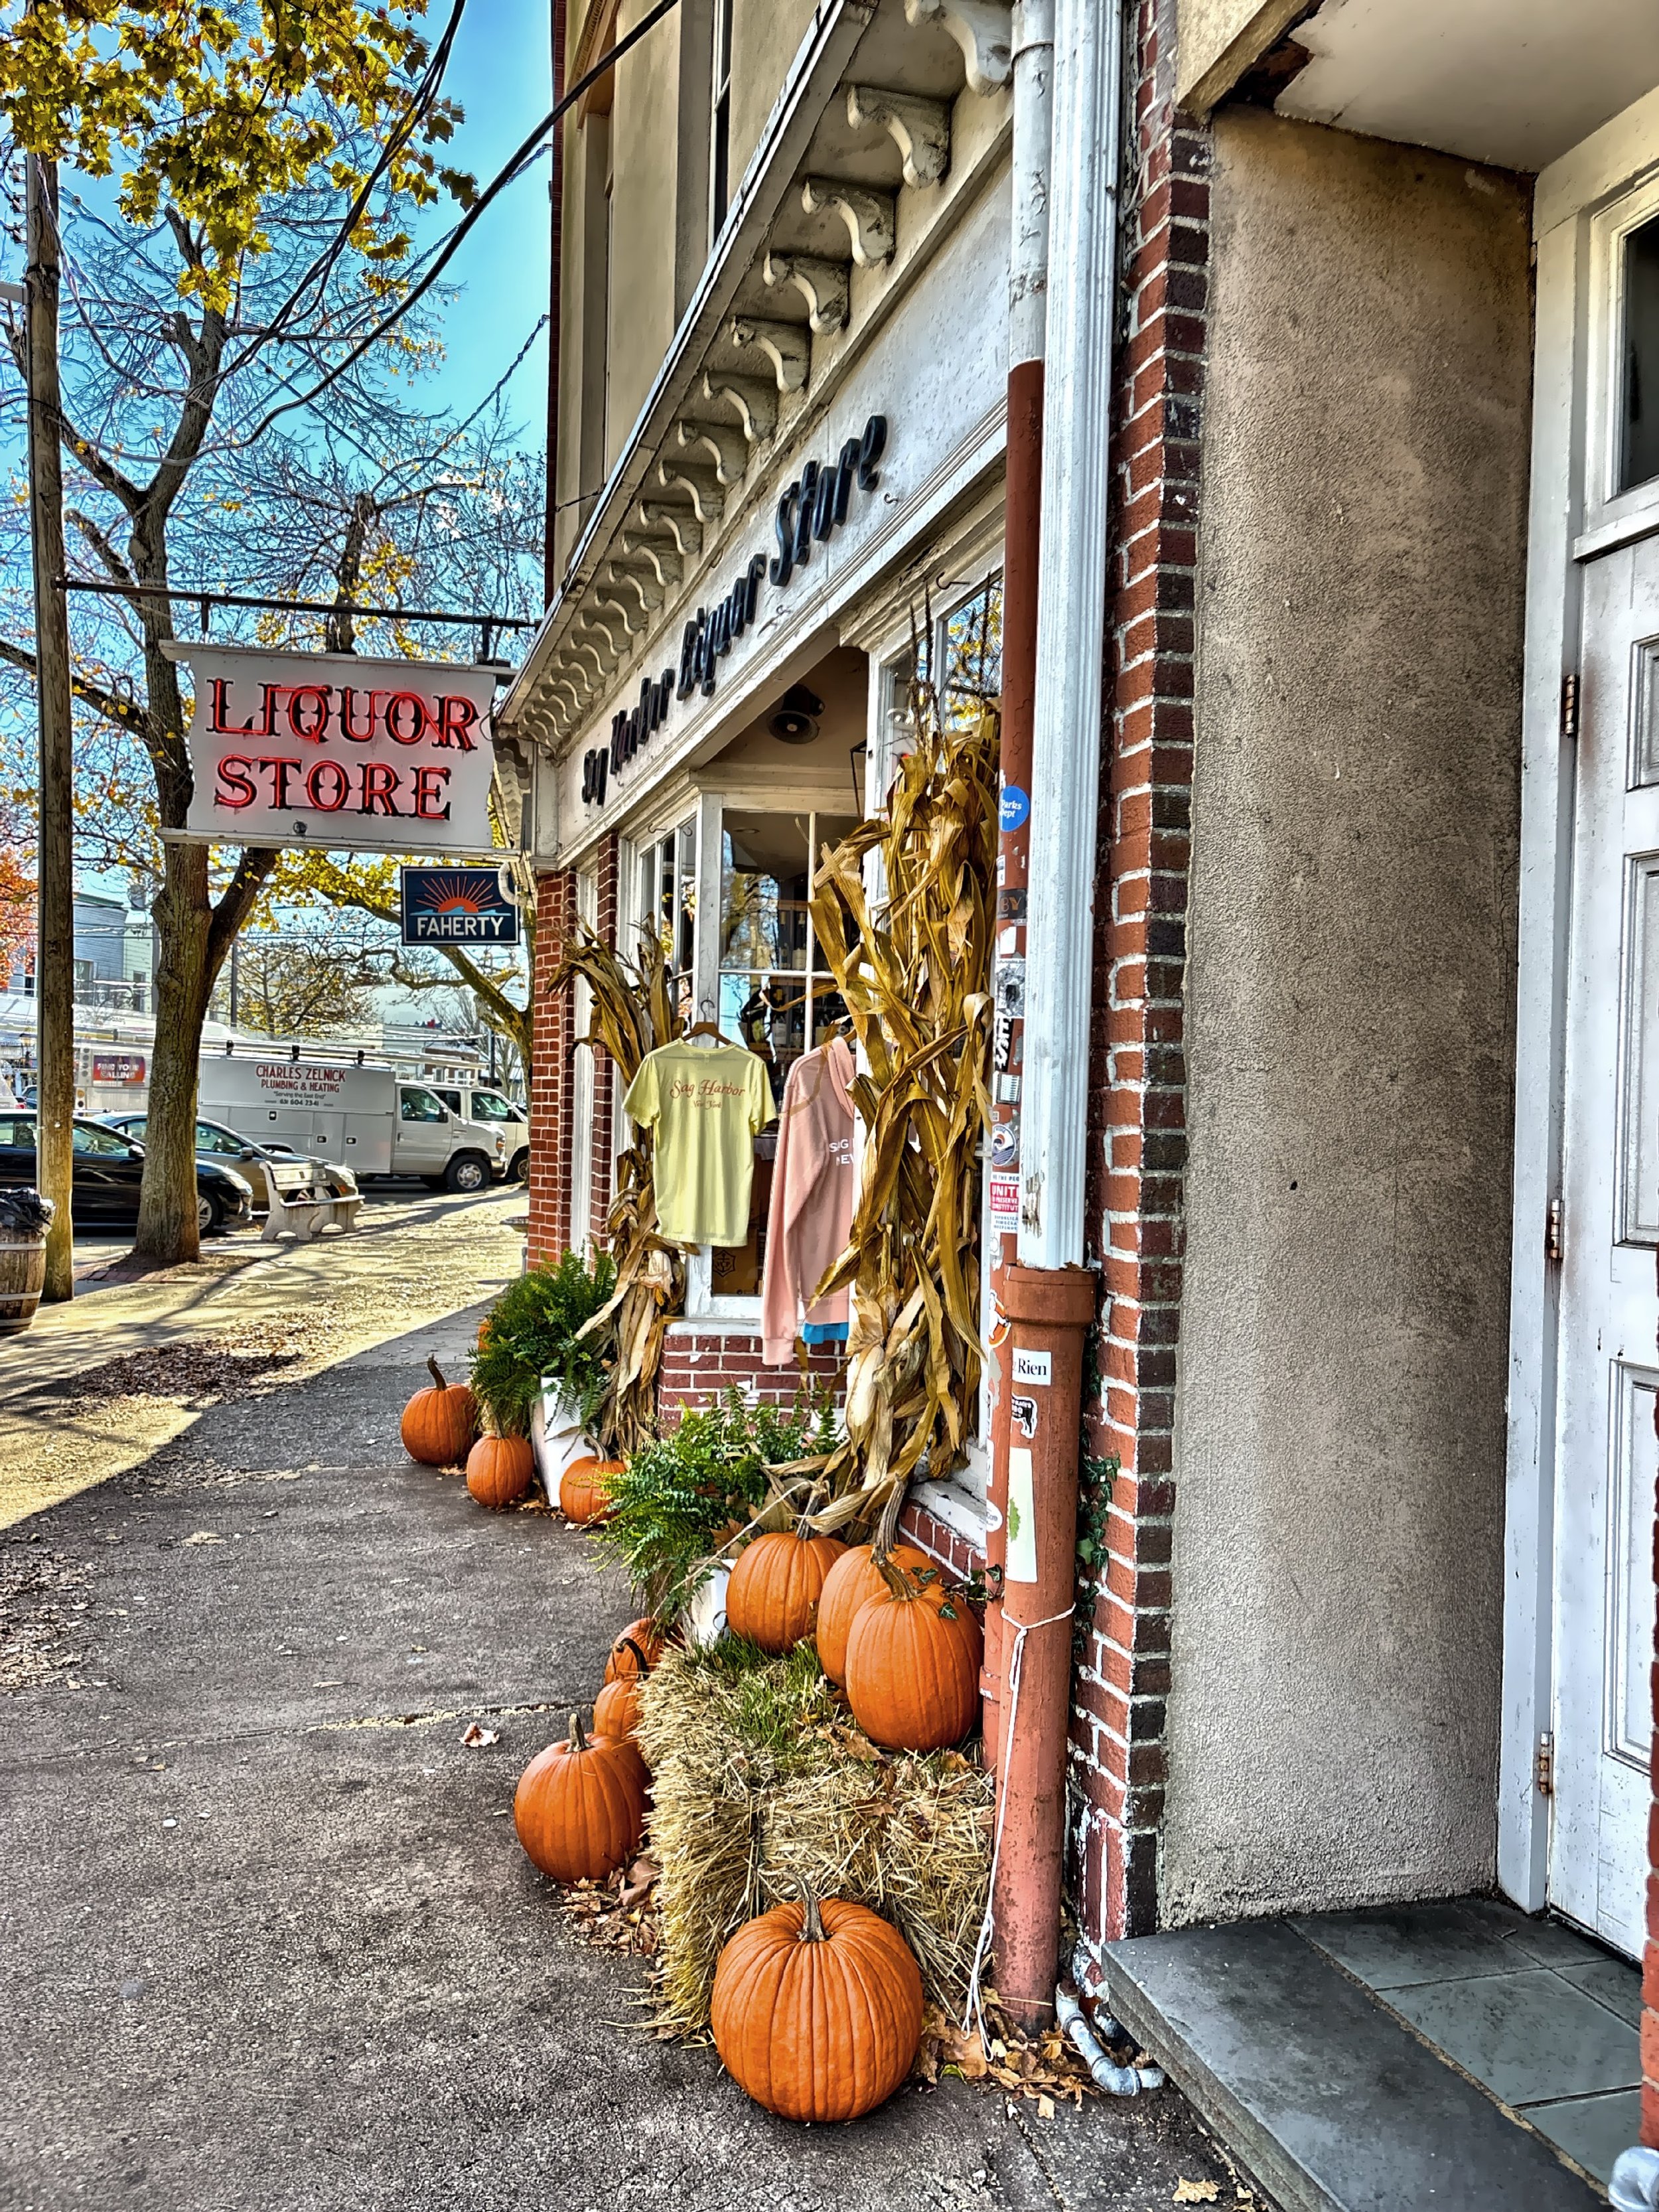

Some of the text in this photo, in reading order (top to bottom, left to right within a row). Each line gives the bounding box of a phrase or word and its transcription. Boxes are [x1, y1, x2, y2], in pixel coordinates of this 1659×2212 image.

[676, 553, 767, 701] Liquor
[769, 413, 888, 587] Store
[206, 678, 480, 751] LIQUOR
[214, 754, 451, 821] STORE
[416, 915, 504, 938] FAHERTY
[255, 1065, 346, 1082] CHARLES ZELNICK
[261, 1079, 340, 1093] PLUMBING & HEATING
[670, 1079, 745, 1098] Sag Harbor
[704, 1100, 722, 1110] York
[1018, 1358, 1046, 1375] Rien
